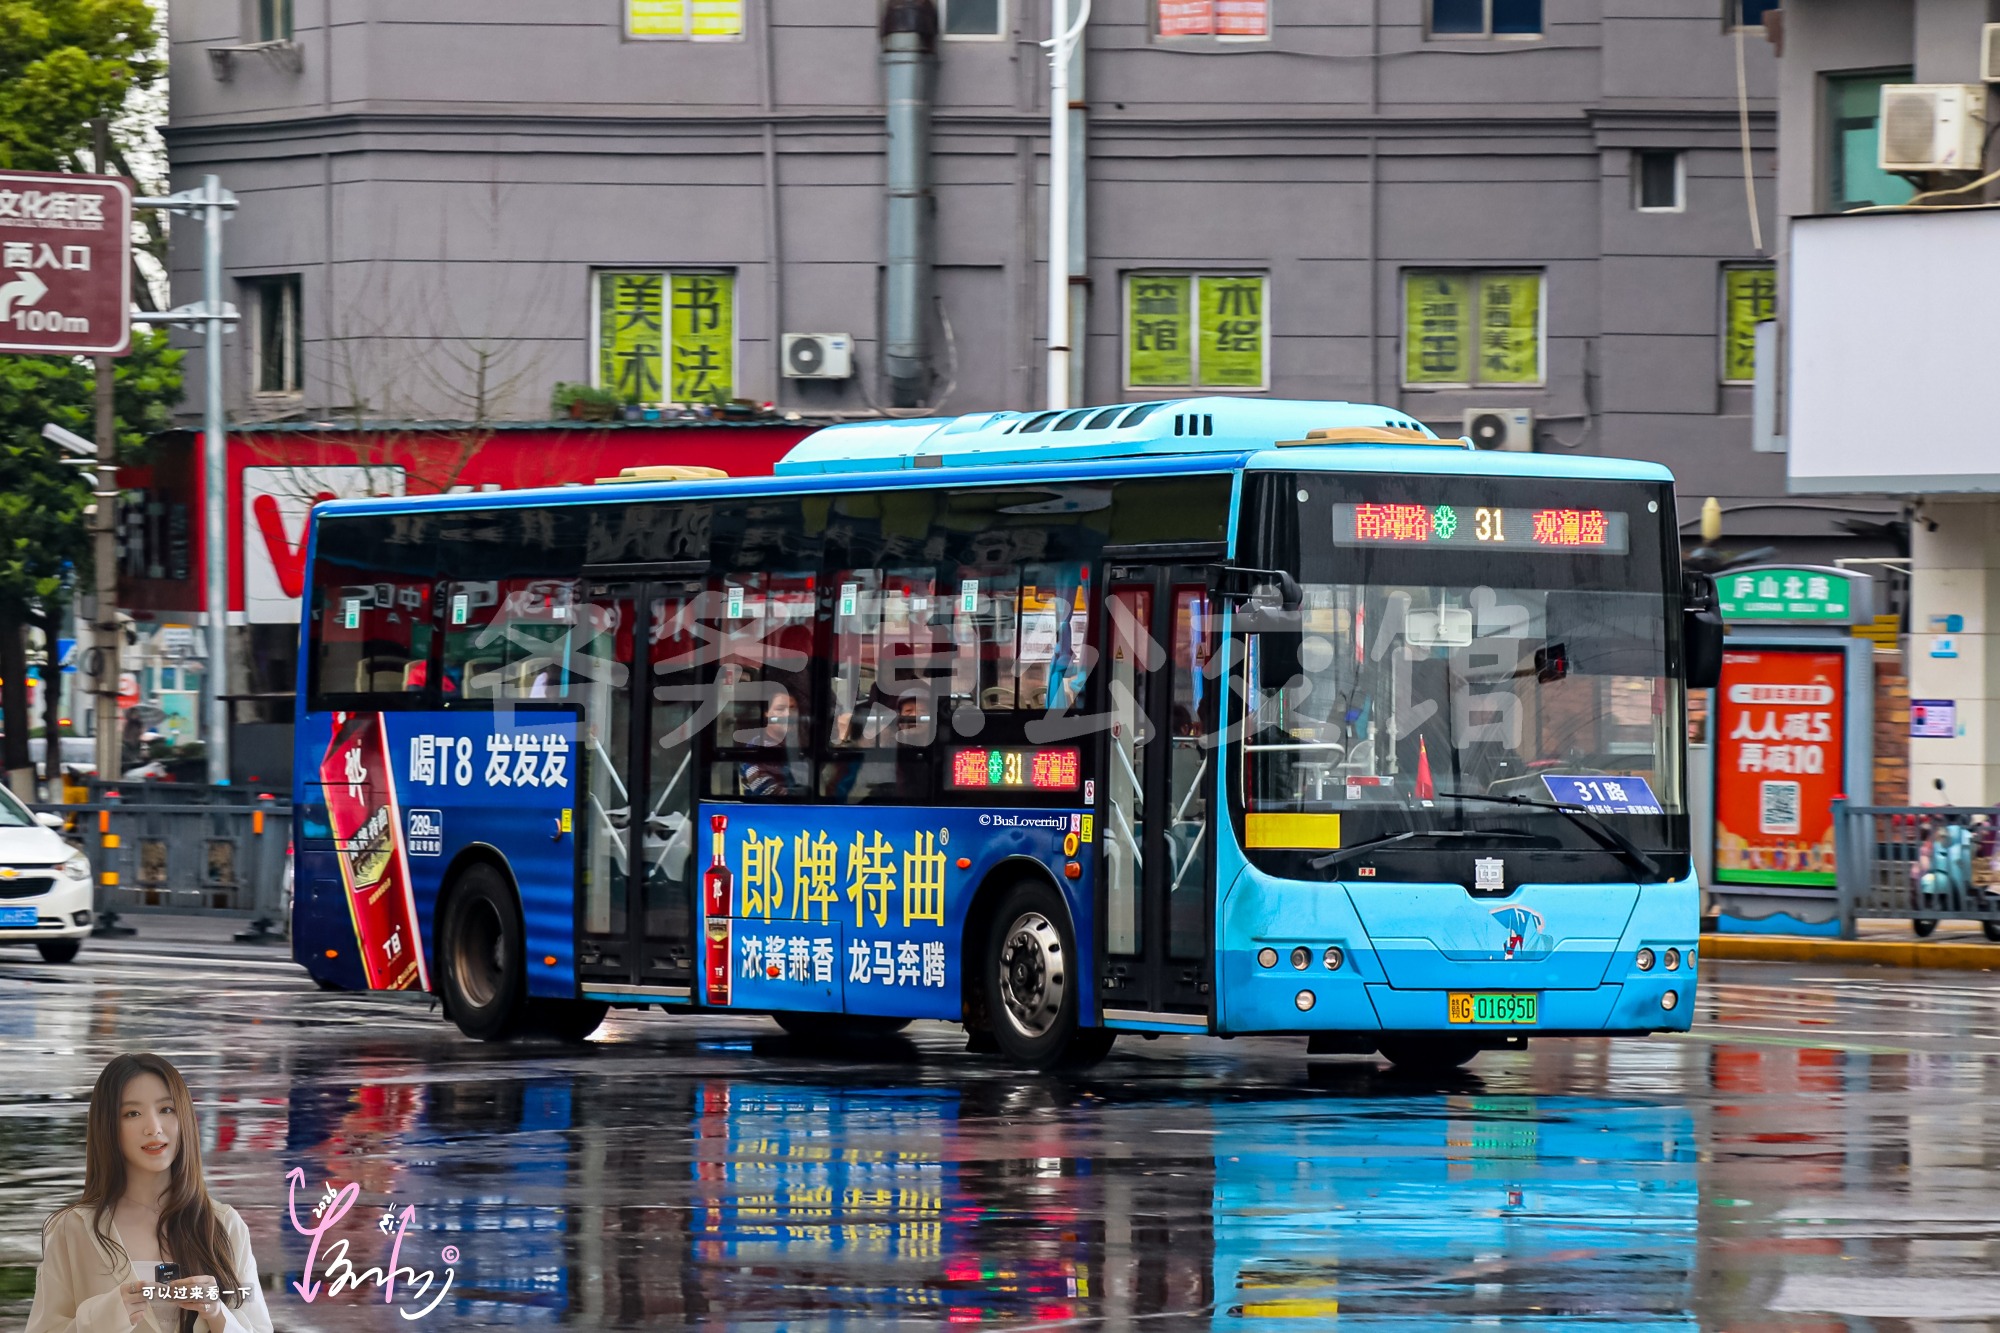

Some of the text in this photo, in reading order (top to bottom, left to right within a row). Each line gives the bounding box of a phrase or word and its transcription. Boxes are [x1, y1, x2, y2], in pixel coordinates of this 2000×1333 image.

[0, 188, 105, 221] 文化街区
[3, 241, 91, 271] 西入口
[11, 310, 89, 333] 100m
[1474, 508, 1505, 541] 31
[1733, 575, 1830, 600] 庐山北路
[409, 733, 569, 788] 喝T8 发发发
[1005, 753, 1023, 784] 31
[1573, 781, 1628, 802] 31路
[741, 828, 947, 928] 郎牌特曲
[741, 935, 946, 988] 浓酱兼香 龙马奔腾
